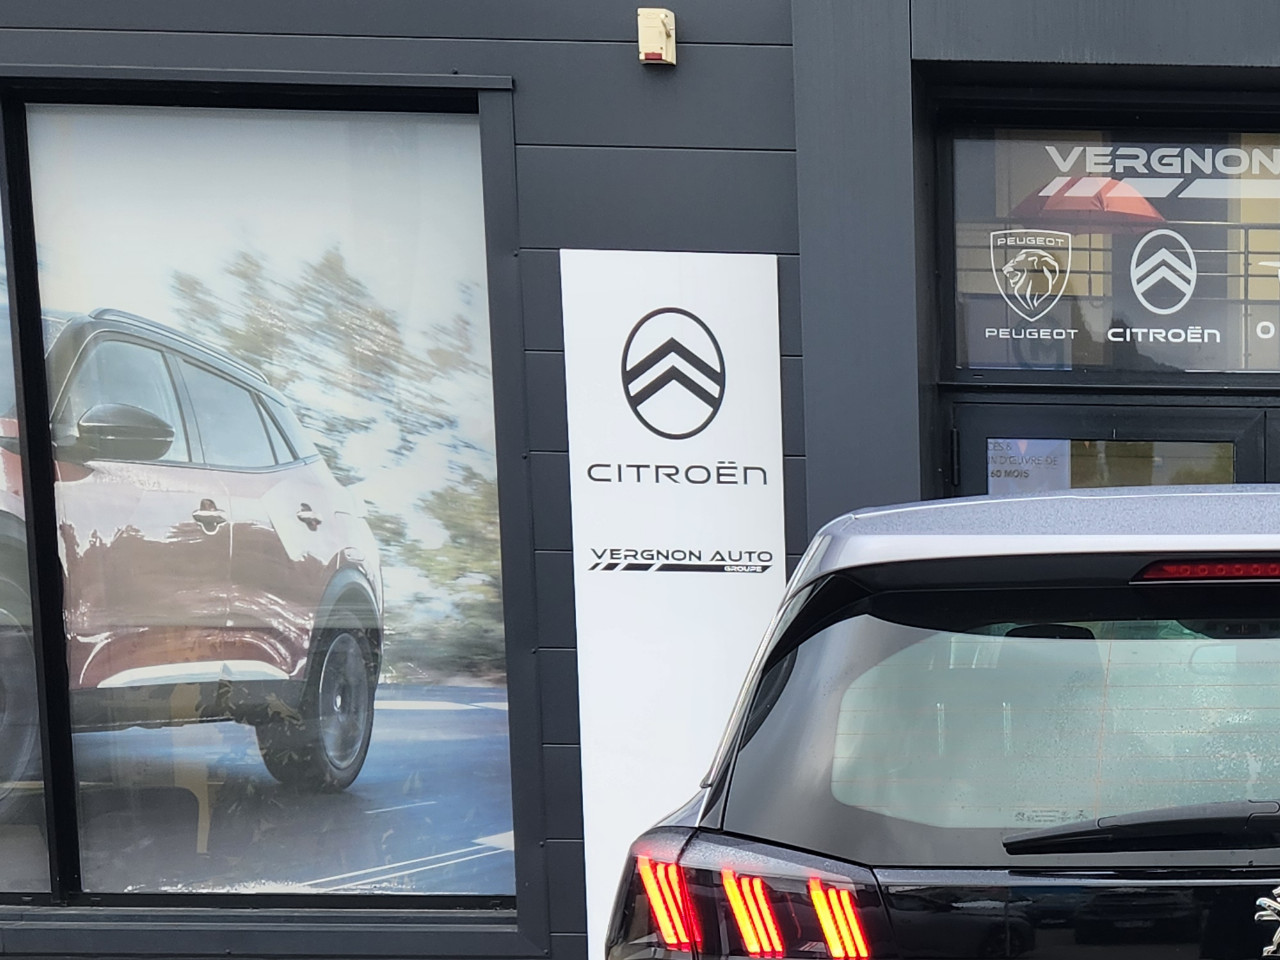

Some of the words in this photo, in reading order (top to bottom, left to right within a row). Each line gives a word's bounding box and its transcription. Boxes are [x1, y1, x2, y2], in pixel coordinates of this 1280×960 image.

[997, 235, 1064, 247] PEUGEOT
[985, 328, 1079, 340] PEUGEOT
[1004, 469, 1030, 478] MOIS
[590, 549, 702, 562] VERGNON
[709, 550, 773, 563] AUTO
[724, 565, 763, 573] GROUPE
